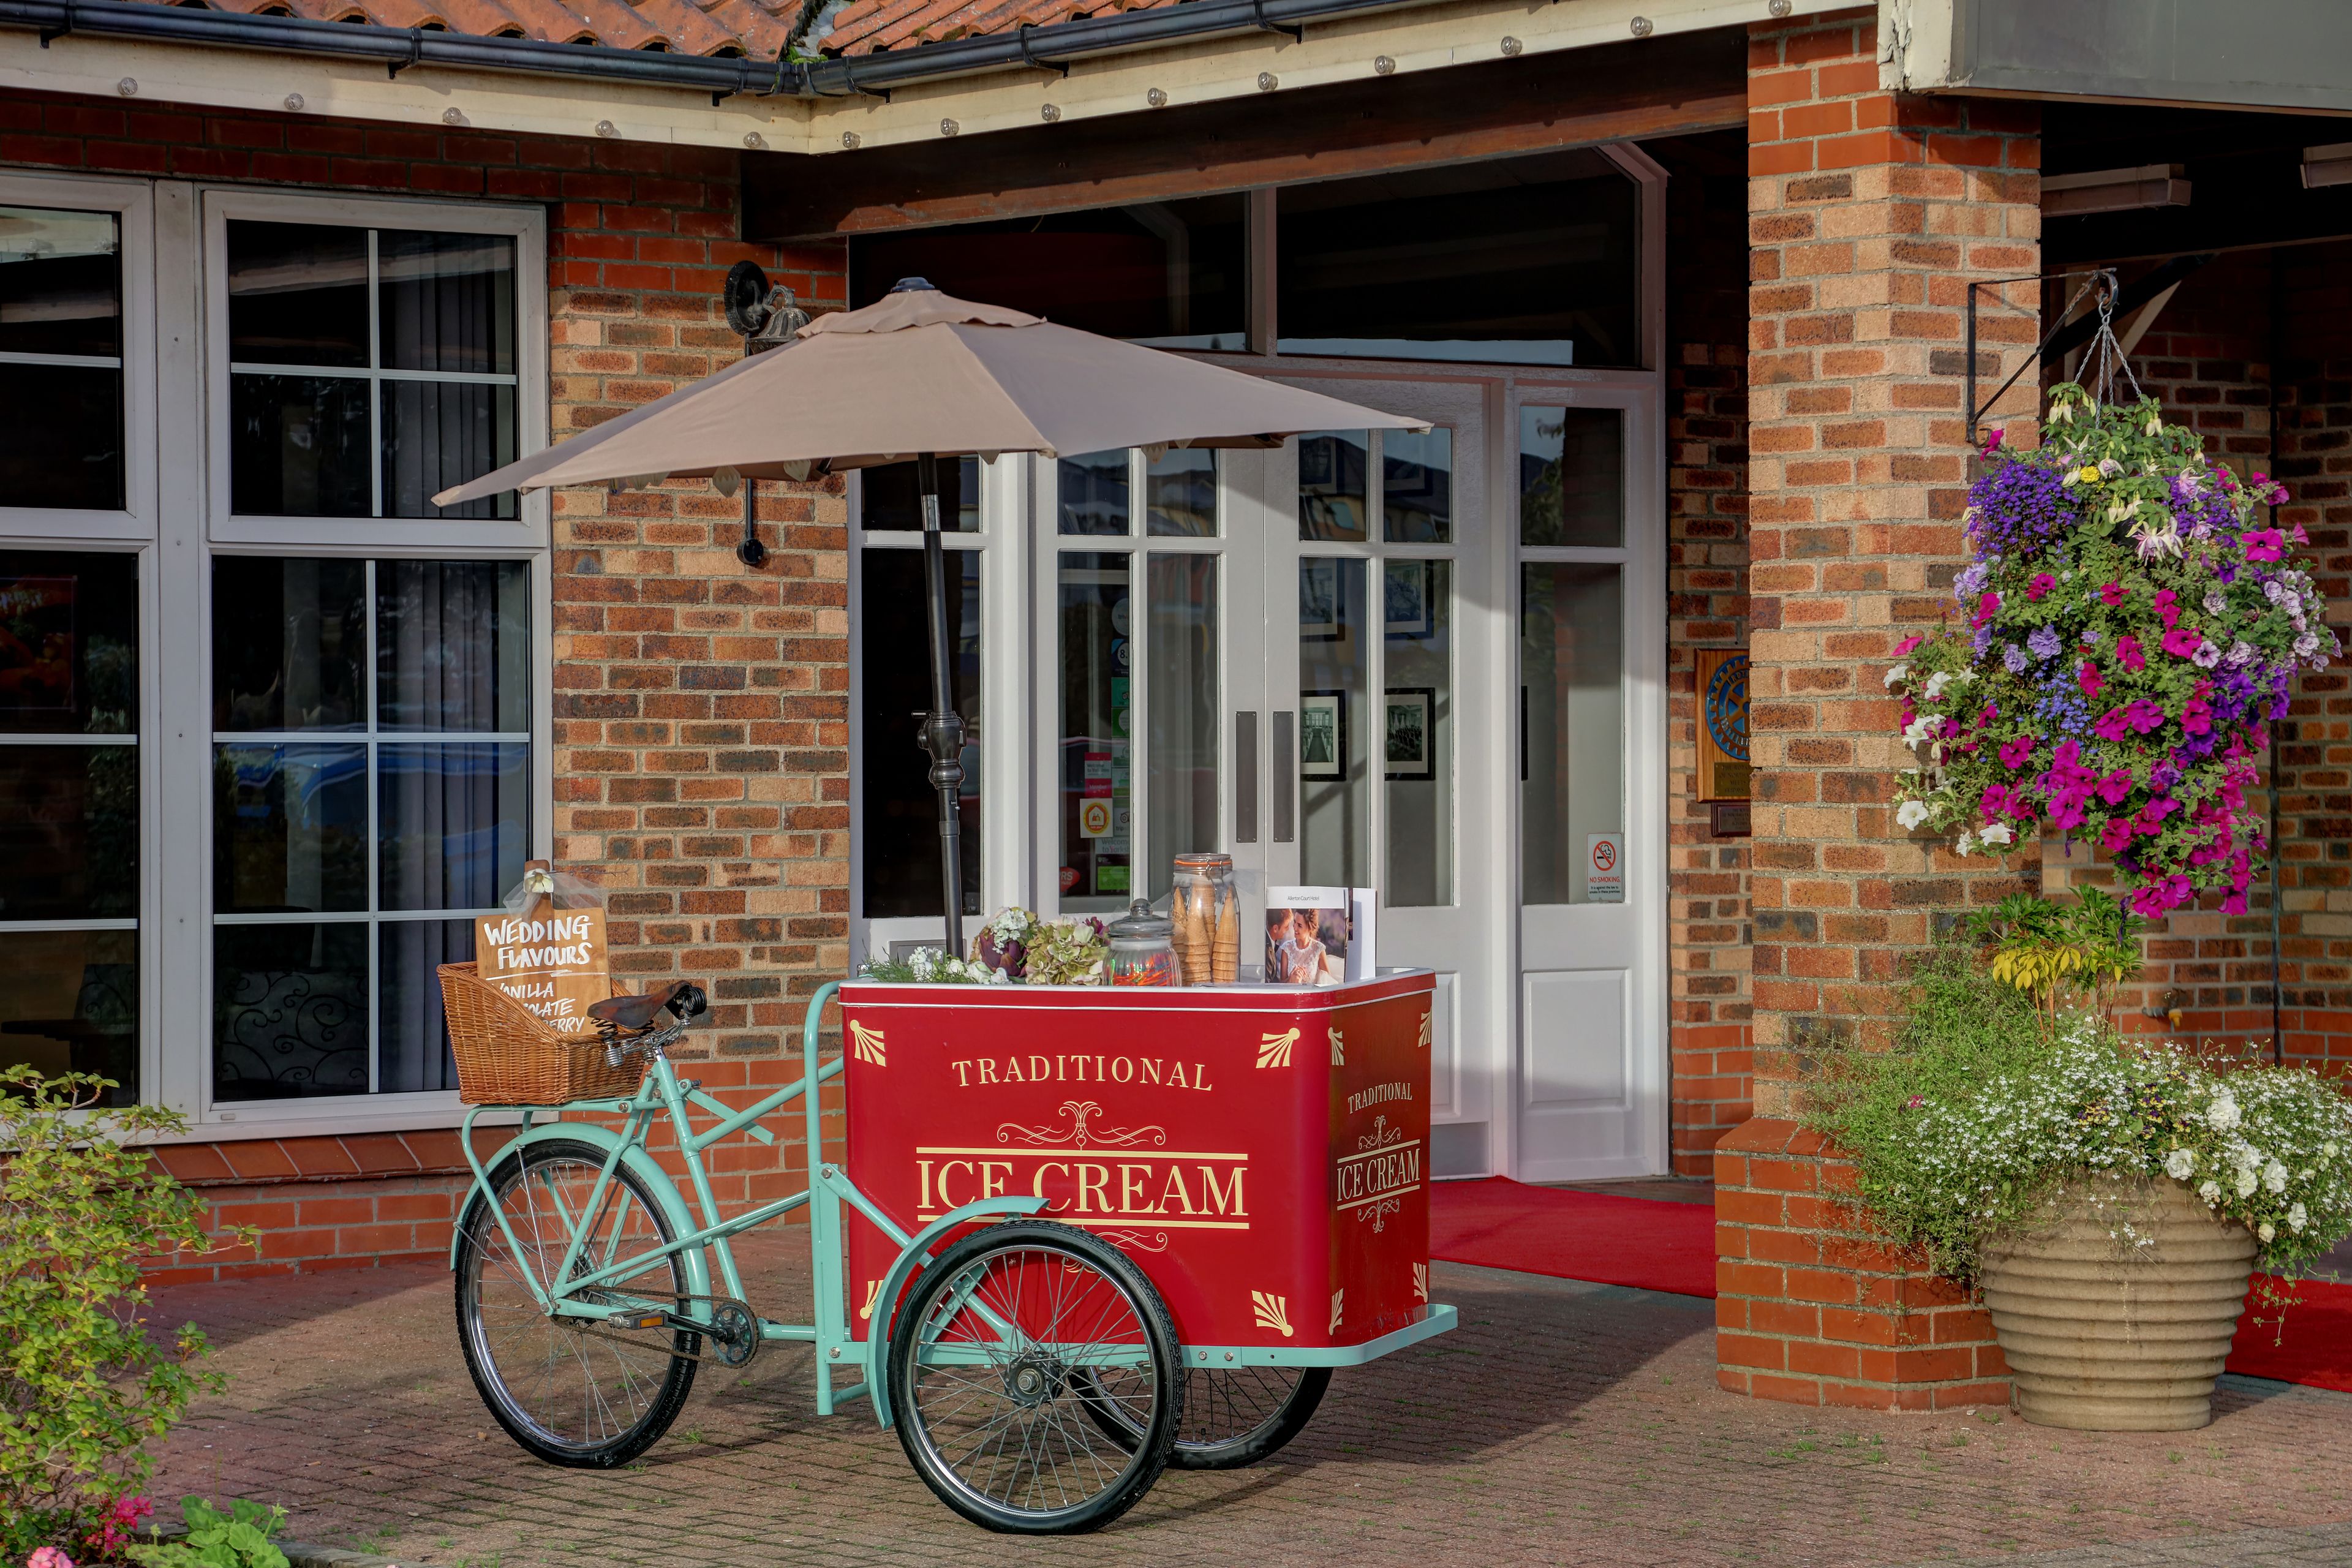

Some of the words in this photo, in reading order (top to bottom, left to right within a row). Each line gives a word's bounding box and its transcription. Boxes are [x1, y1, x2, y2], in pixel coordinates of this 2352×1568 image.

[1060, 871, 1073, 881] RS
[484, 915, 594, 946] WEDDING
[497, 942, 592, 970] FLAVOURS
[951, 1054, 1212, 1091] TRADITIONAL
[1348, 1082, 1413, 1115] TRADITIONAL
[916, 1160, 1013, 1209] ICE
[1033, 1162, 1249, 1216] CREAM
[1336, 1163, 1363, 1202] ICE
[1366, 1148, 1420, 1194] CREAM
